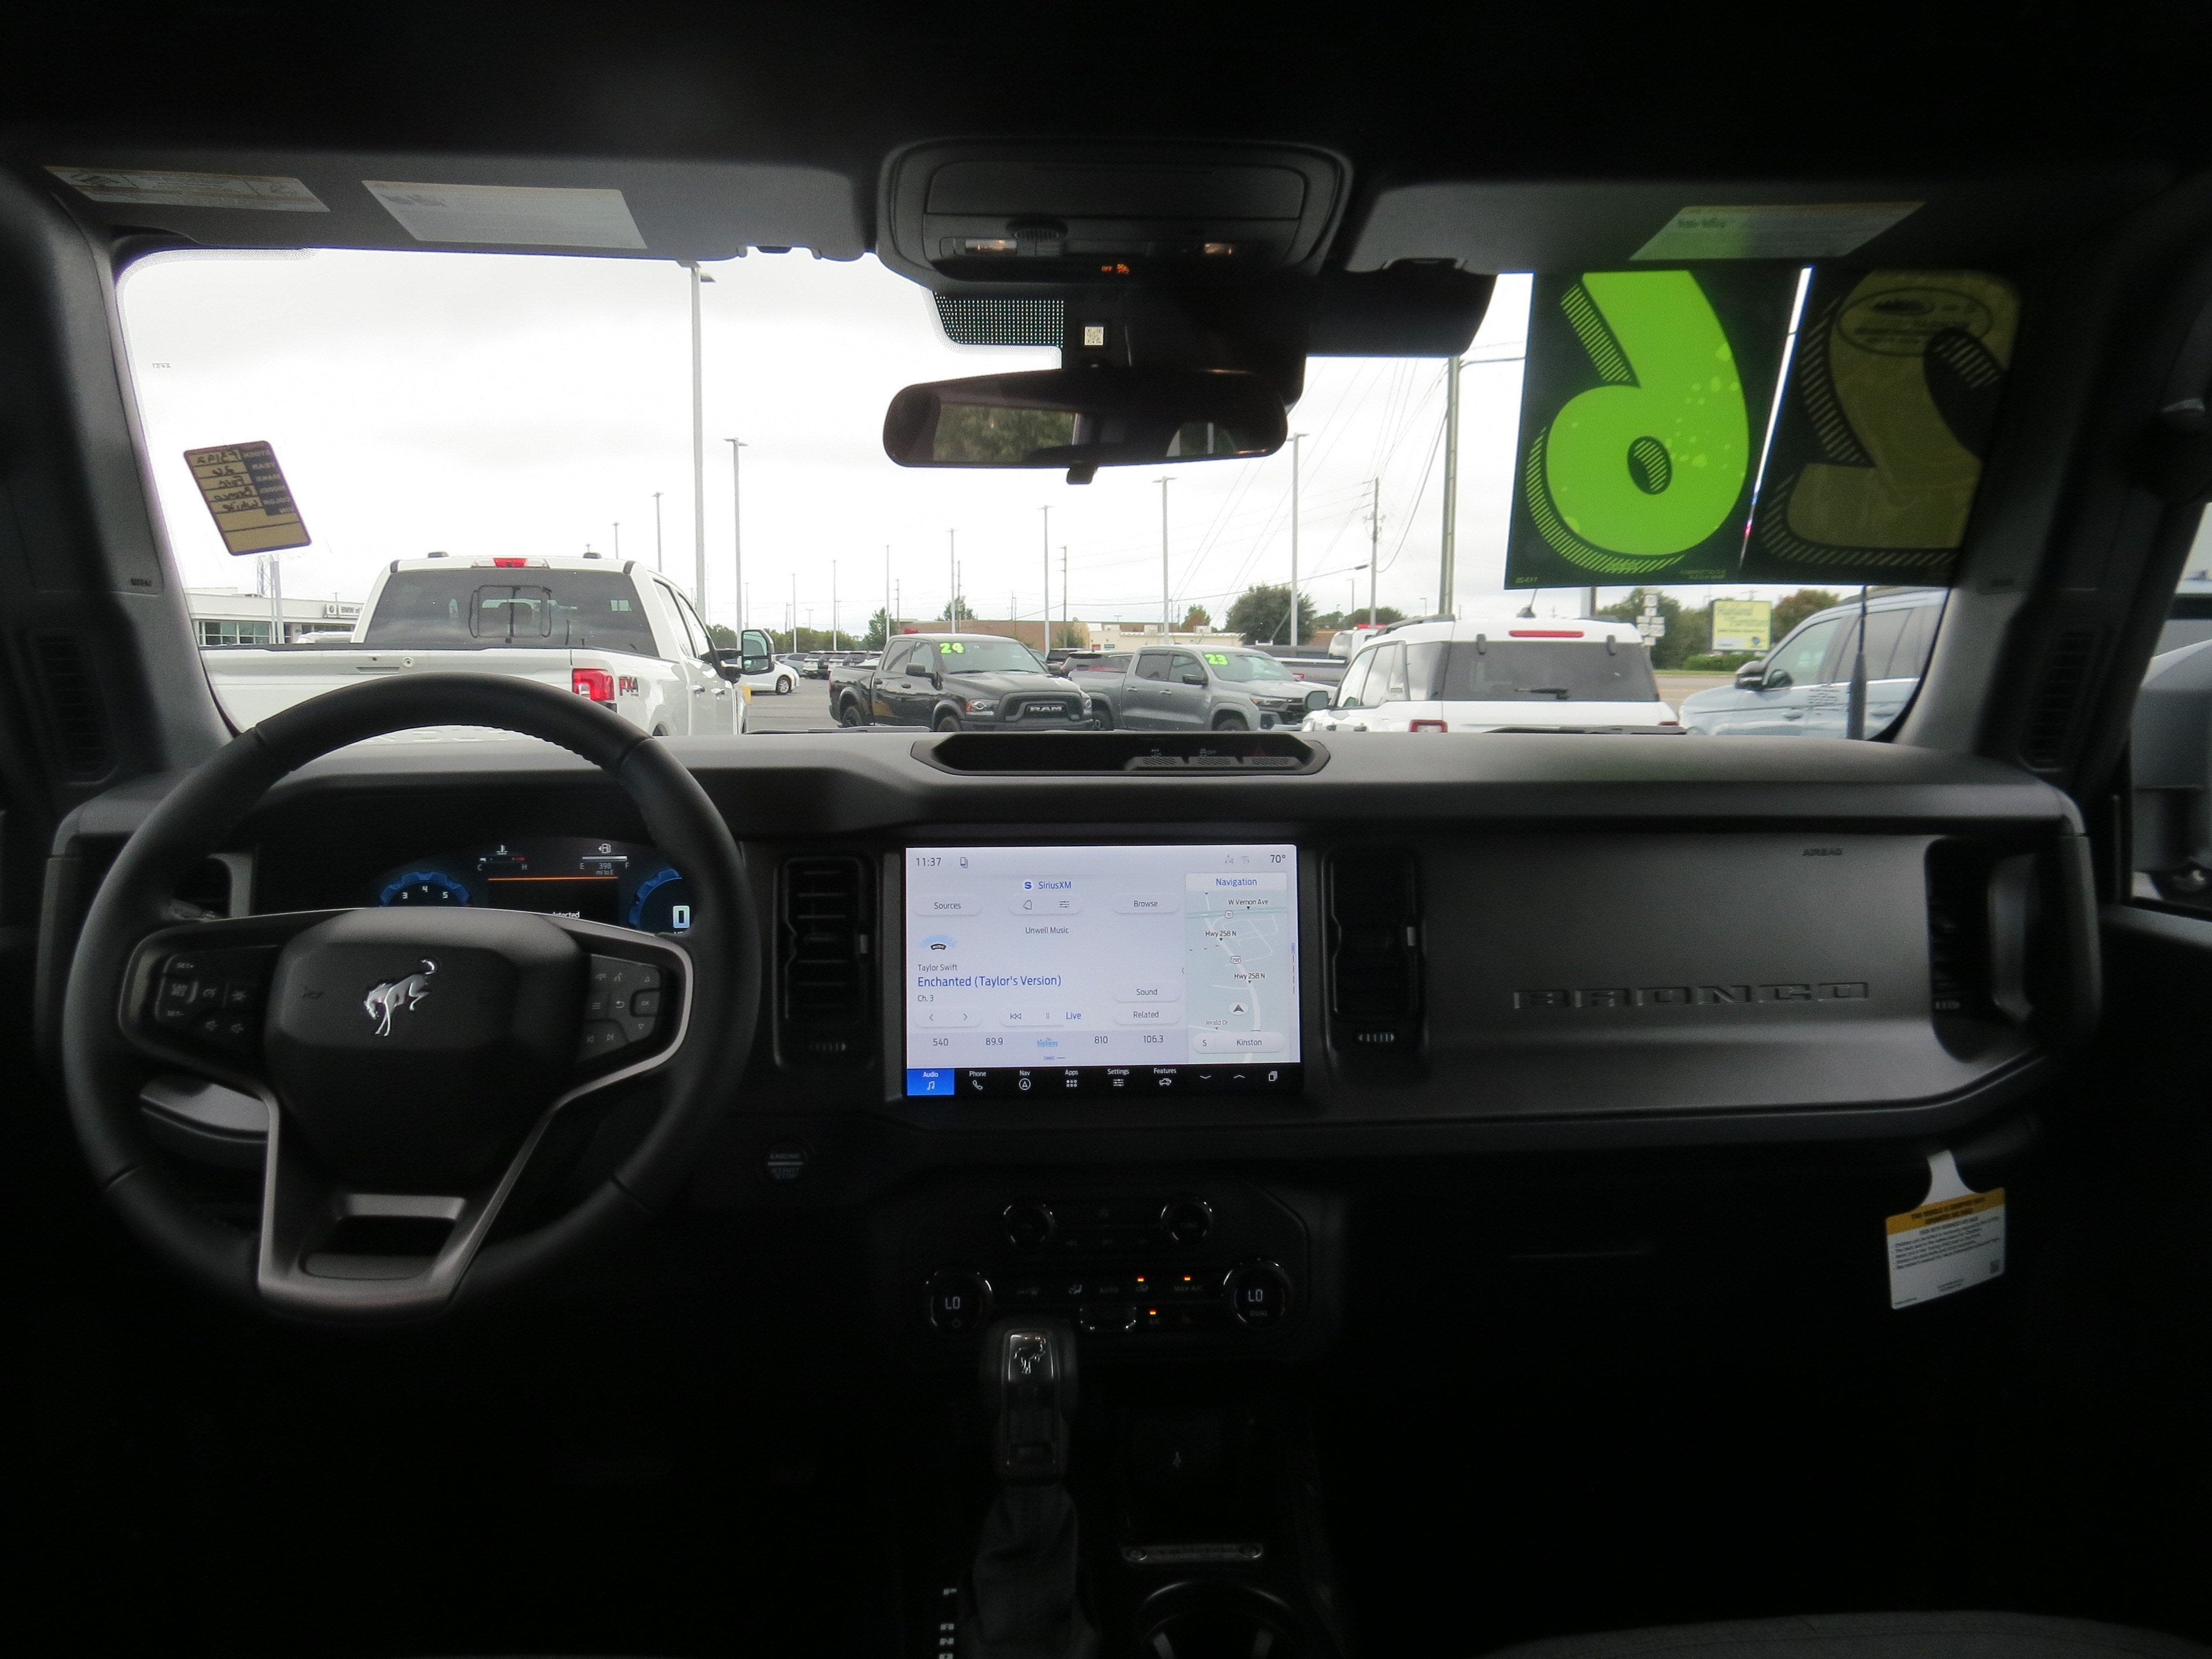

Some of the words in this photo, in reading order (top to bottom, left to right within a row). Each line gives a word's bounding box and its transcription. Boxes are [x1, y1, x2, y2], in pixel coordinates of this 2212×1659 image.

[940, 642, 964, 655] 24
[1205, 654, 1229, 665] 23
[1029, 705, 1062, 713] RAM
[916, 857, 942, 867] 11:37
[1270, 854, 1286, 863] 70°
[1038, 881, 1072, 889] SiriusXM
[1216, 878, 1258, 886] Navigation
[934, 901, 961, 910] Sources
[673, 905, 690, 928] 0
[917, 964, 938, 972] Taylor
[940, 963, 958, 972] Swift
[917, 976, 972, 987] Enchanted
[974, 975, 1018, 988] (Taylor's
[1020, 975, 1062, 986] Version)
[1512, 981, 1869, 1010] BRONCO
[1066, 1011, 1082, 1020] Live
[1133, 1010, 1159, 1019] Related
[932, 1038, 949, 1046] 540
[985, 1037, 1004, 1046] 89.9
[1094, 1036, 1108, 1044] 810
[1143, 1035, 1164, 1044] 106.3
